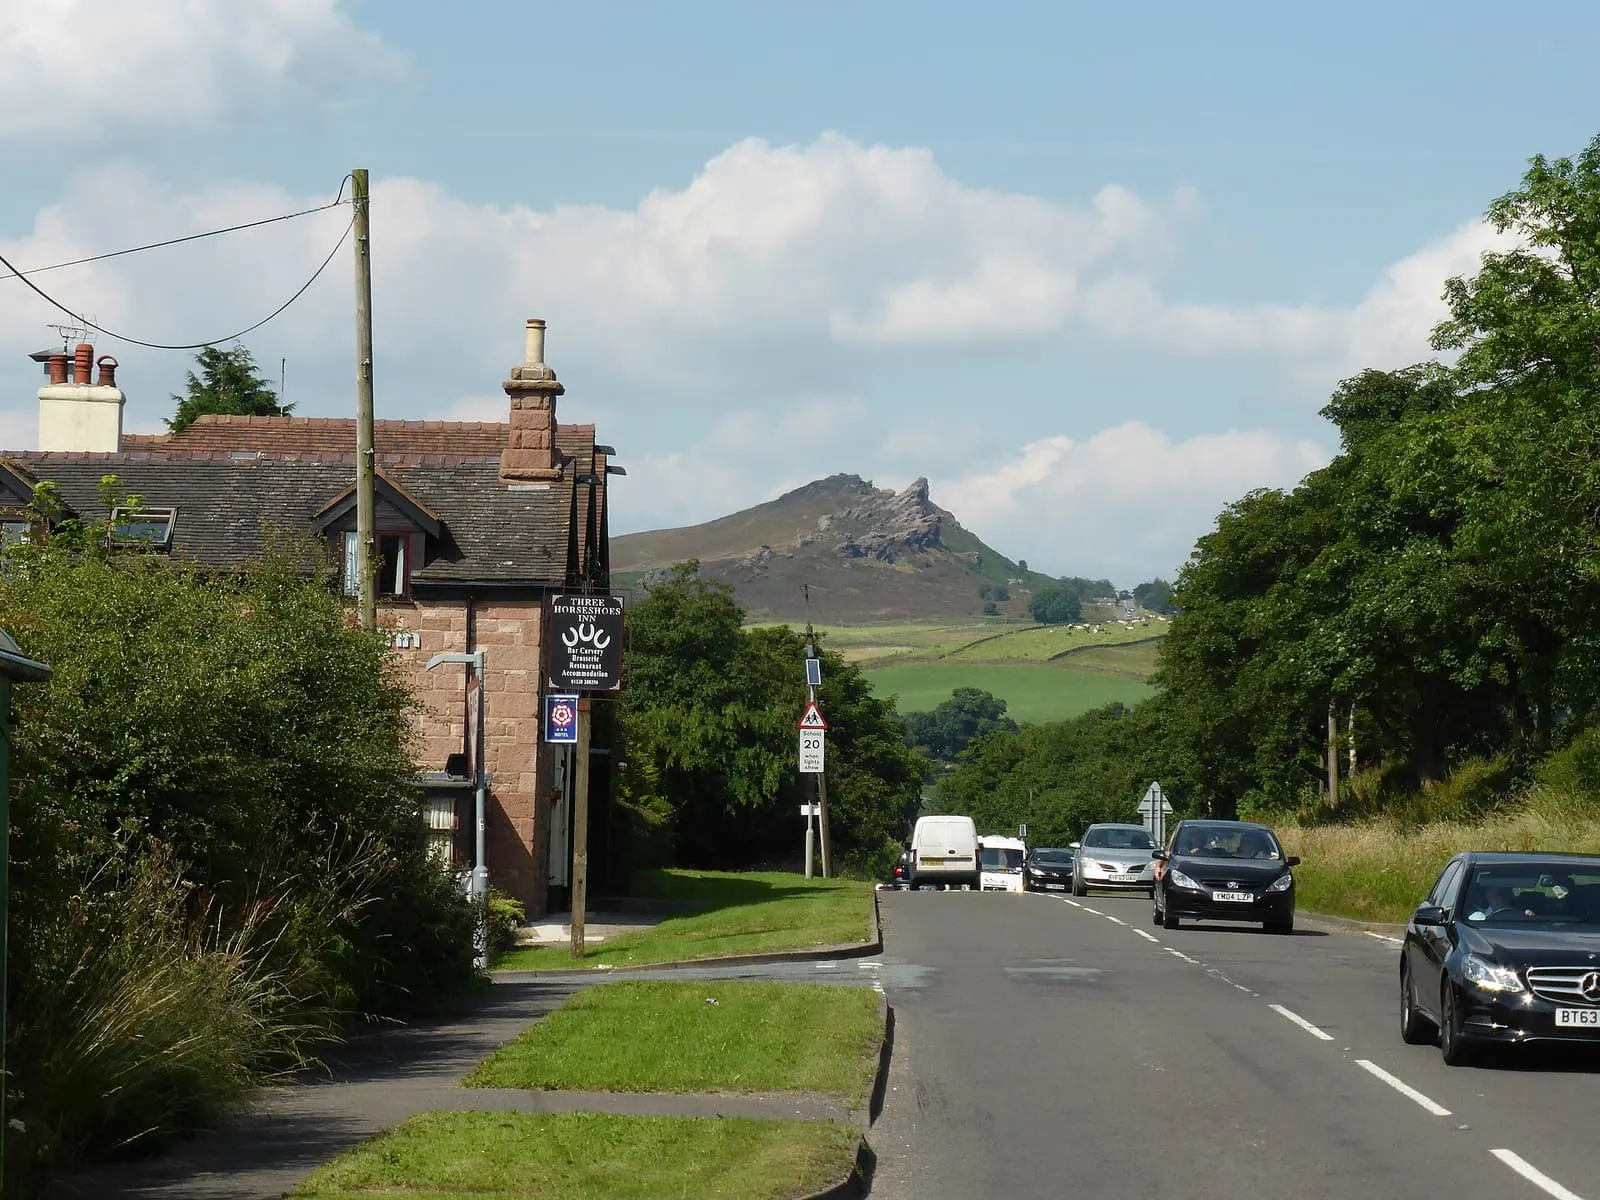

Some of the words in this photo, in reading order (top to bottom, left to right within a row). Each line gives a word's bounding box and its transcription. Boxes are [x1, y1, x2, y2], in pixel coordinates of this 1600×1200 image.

[570, 597, 605, 606] THREE
[554, 605, 621, 615] HORSESHOES
[578, 614, 596, 622] INN
[572, 654, 600, 662] Brasserie
[569, 662, 602, 670] Restaurant
[561, 670, 609, 678] Accommodation
[804, 739, 820, 749] 20
[1562, 1010, 1598, 1024] BT63
